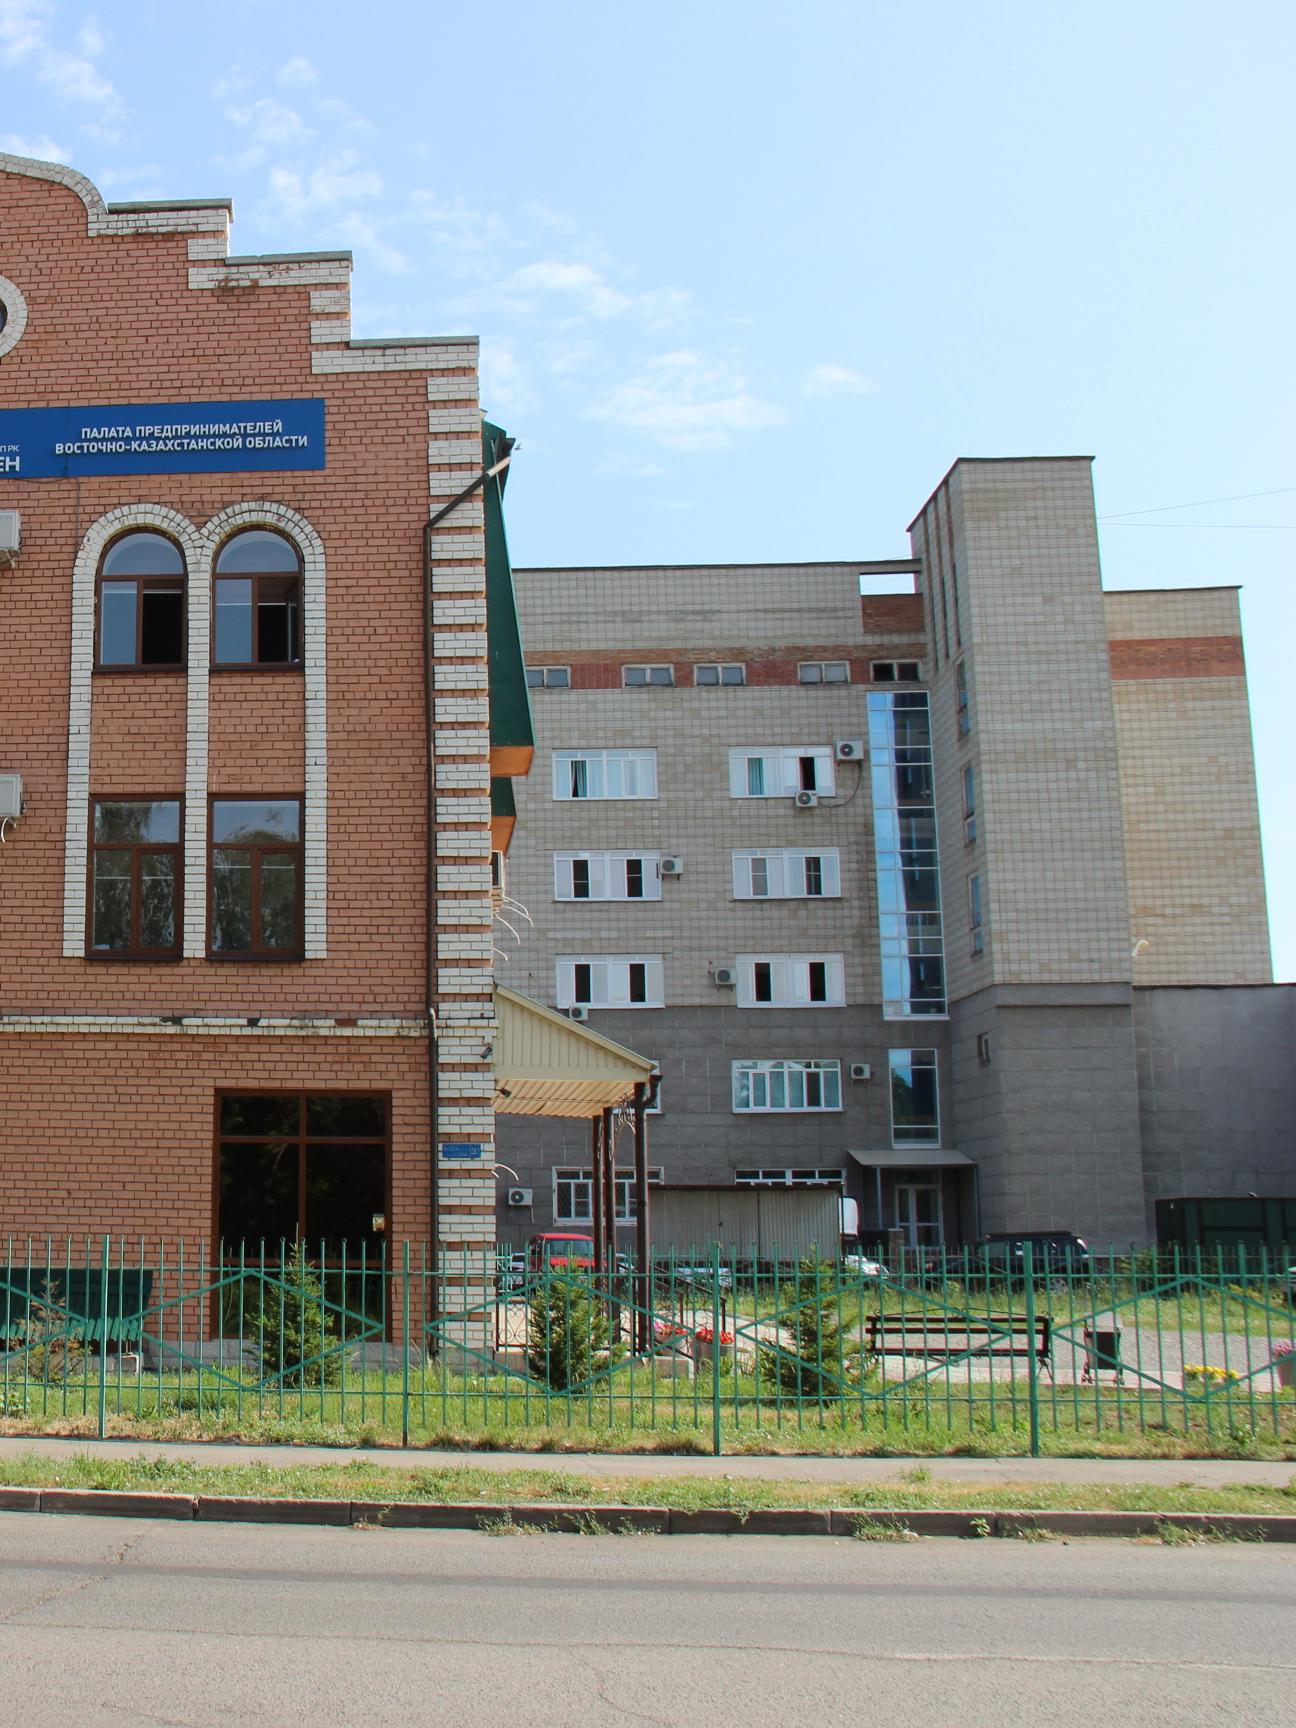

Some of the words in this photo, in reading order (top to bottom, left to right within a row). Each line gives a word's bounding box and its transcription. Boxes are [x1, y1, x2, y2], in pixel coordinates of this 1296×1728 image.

[81, 426, 133, 439] ПАЛАТА
[135, 418, 283, 438] ПРЕДПРИНИМАТЕЛЕЙ
[7, 444, 19, 453] РК
[55, 435, 243, 454] ВОСТОЧНО-КАЗАХСТАНСКОЙ
[245, 435, 308, 448] ОБЛАСТИ
